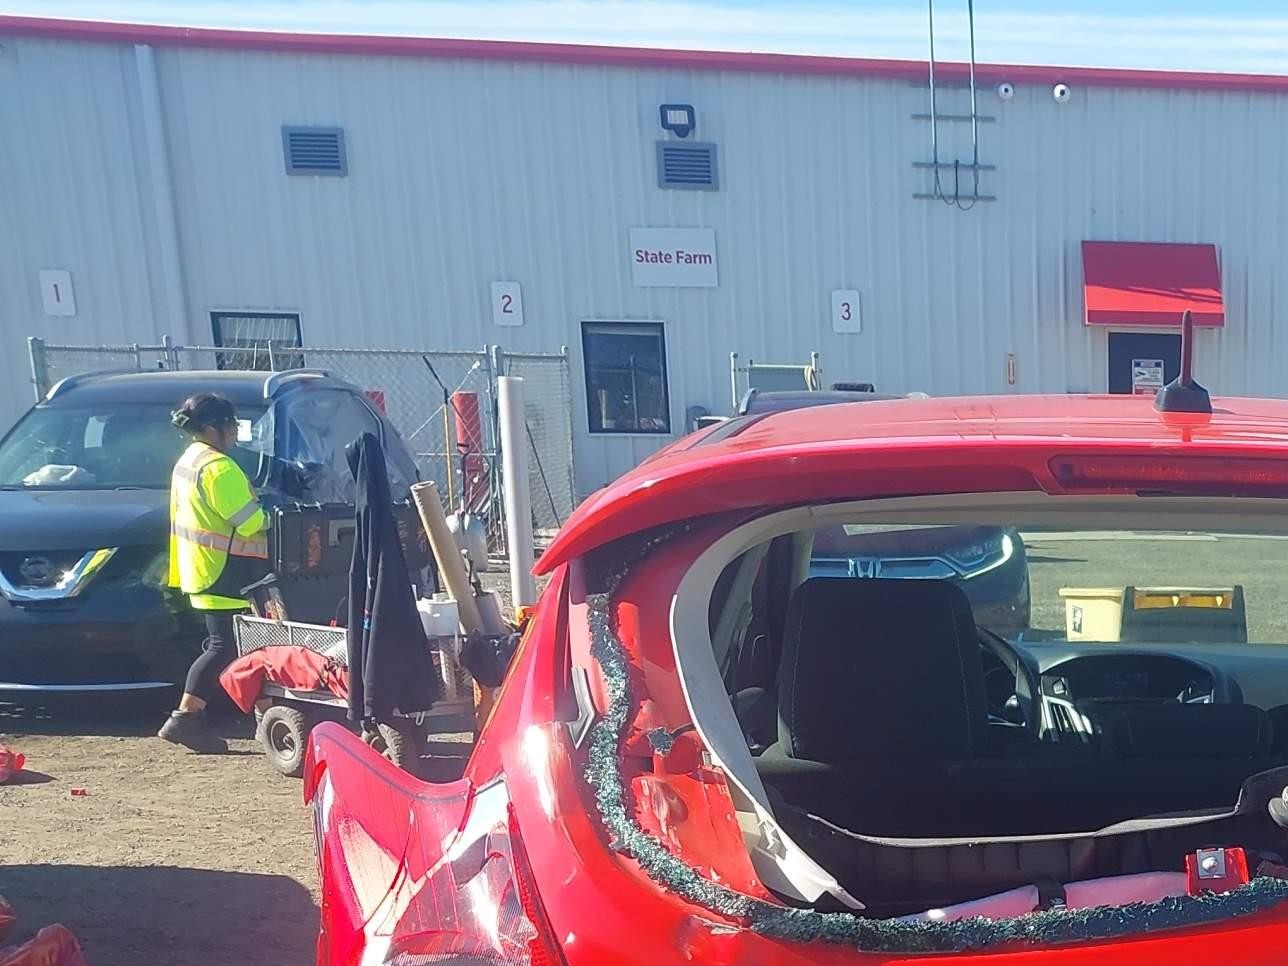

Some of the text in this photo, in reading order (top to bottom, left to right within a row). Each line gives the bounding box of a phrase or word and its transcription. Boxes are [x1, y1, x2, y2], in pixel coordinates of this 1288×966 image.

[635, 249, 712, 265] State Farm
[53, 283, 61, 303] 1
[501, 294, 513, 313] 2
[841, 302, 852, 321] 3
